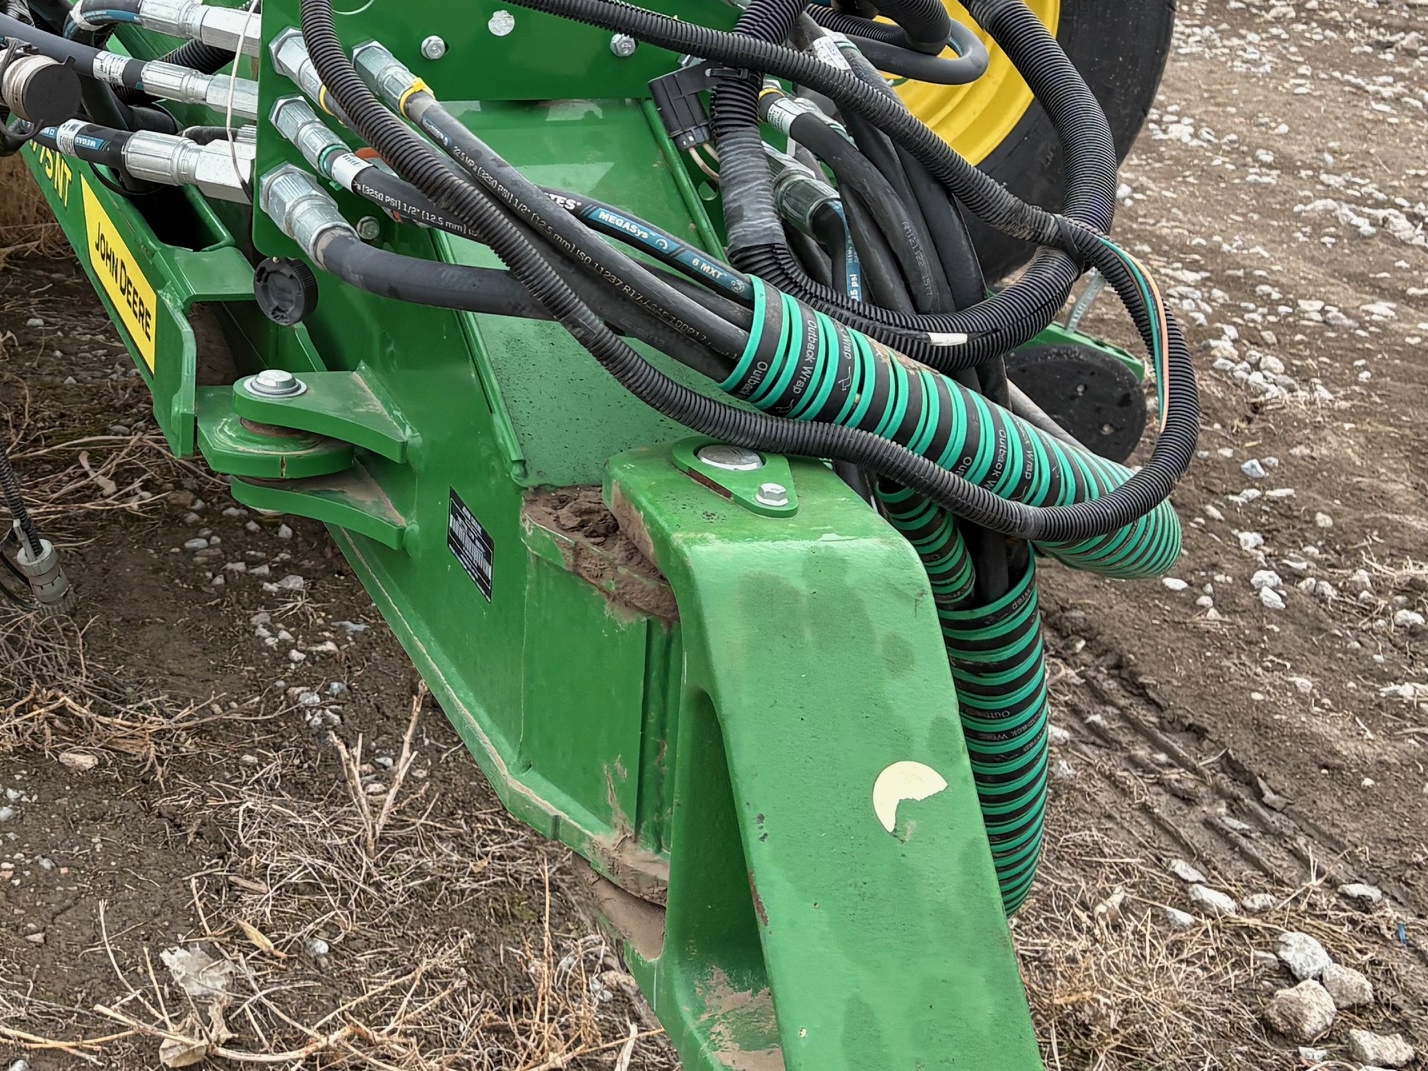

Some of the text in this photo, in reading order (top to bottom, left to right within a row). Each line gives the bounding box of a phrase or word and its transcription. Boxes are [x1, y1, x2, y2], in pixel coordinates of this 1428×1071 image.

[95, 222, 152, 342] JOHN DEERE
[793, 320, 818, 394] Outback Wrap
[841, 333, 852, 359] Wrap
